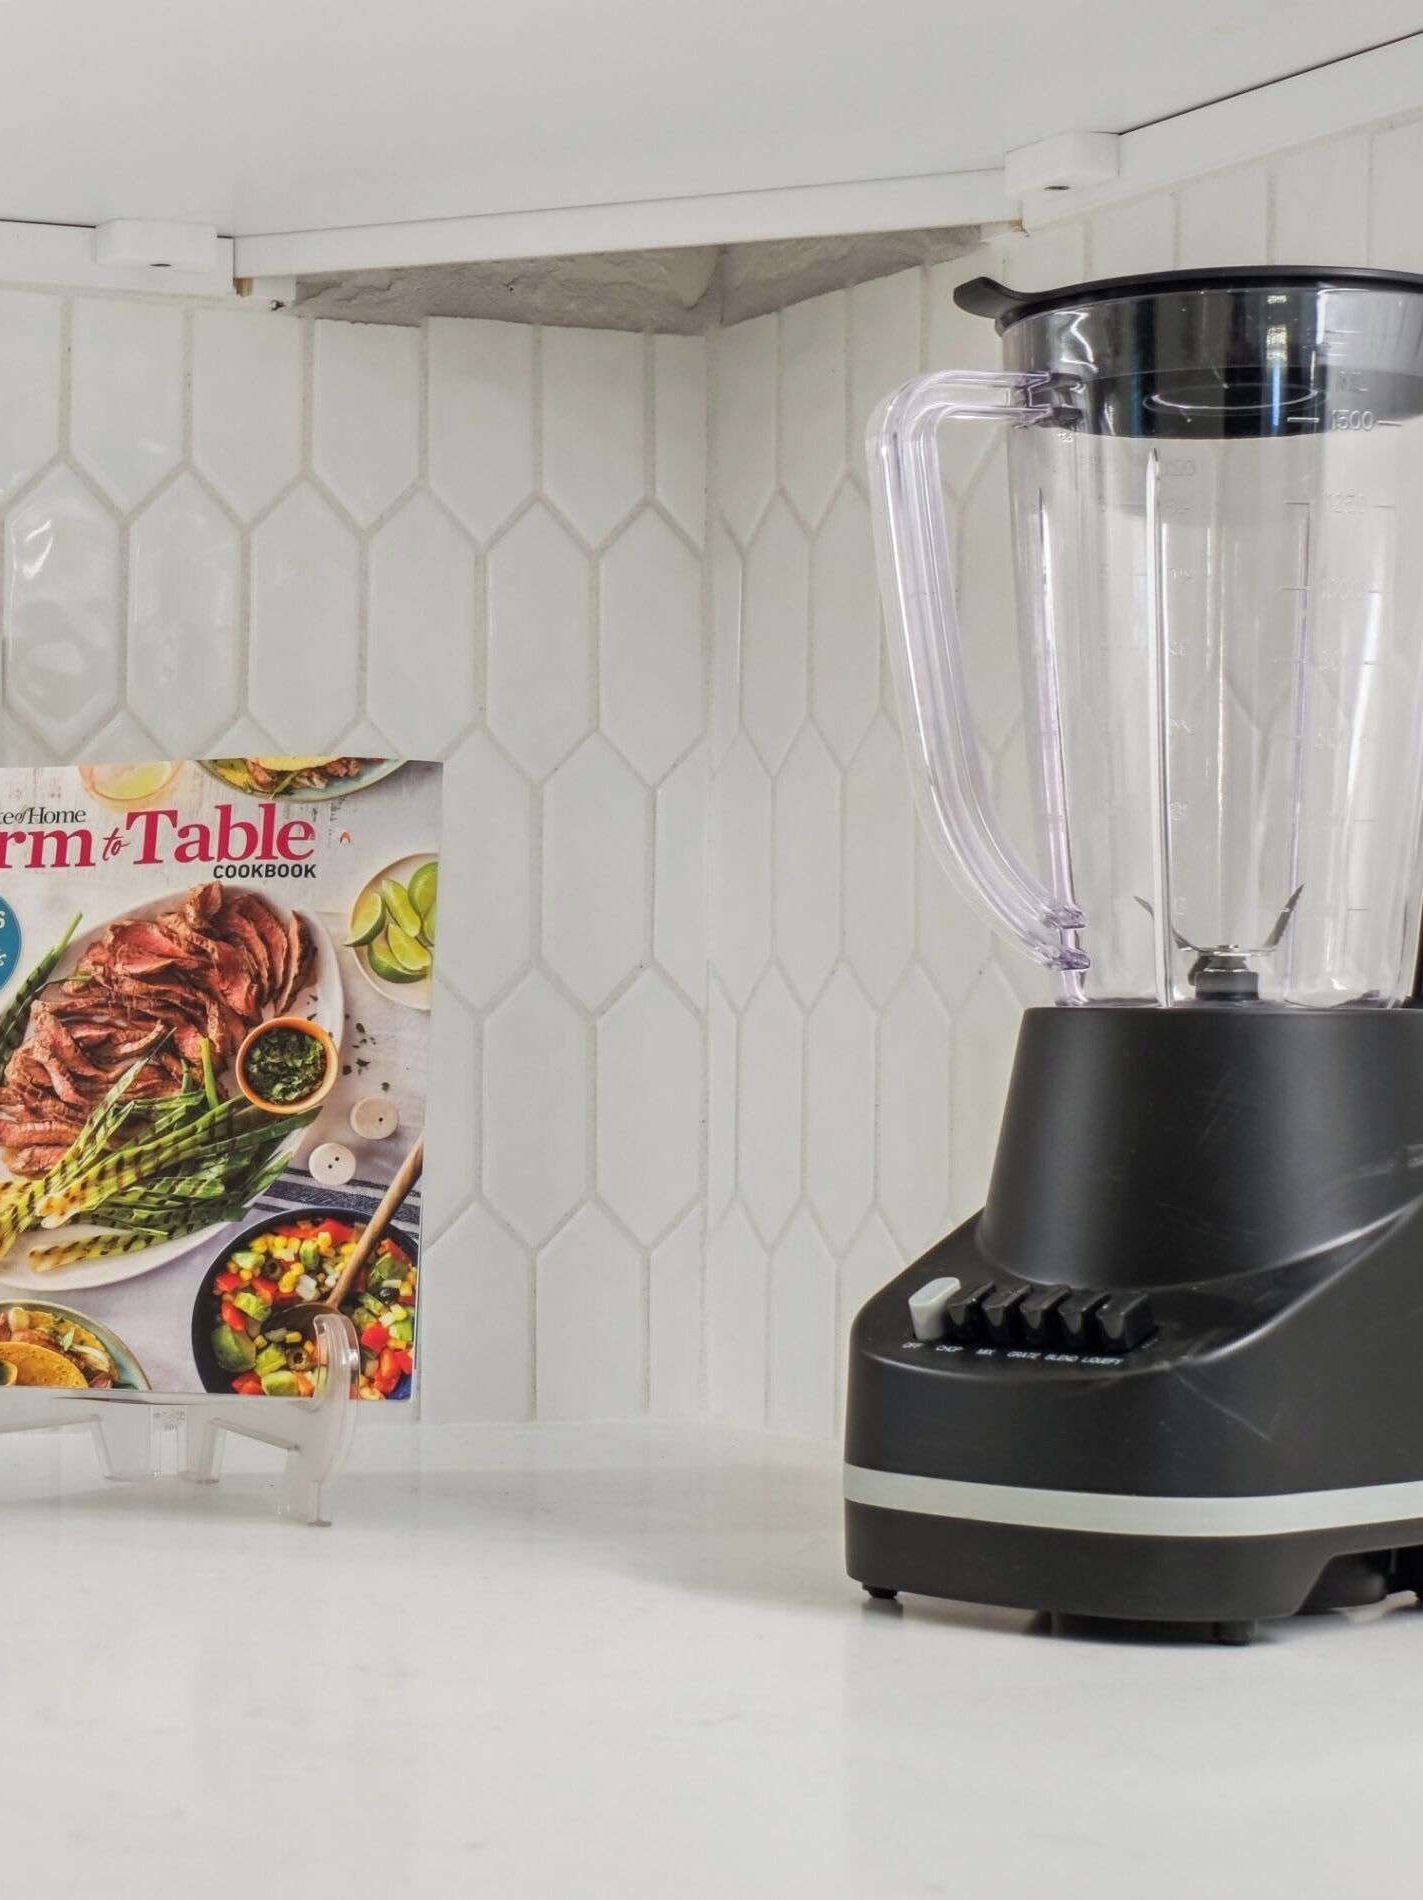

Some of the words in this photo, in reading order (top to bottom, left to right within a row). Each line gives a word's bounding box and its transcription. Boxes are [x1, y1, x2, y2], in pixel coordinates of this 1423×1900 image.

[1331, 409, 1374, 431] 1500
[14, 806, 28, 824] of
[27, 807, 86, 824] Home
[102, 827, 131, 861] to
[126, 803, 316, 865] Table
[213, 863, 317, 879] COOKBOOK
